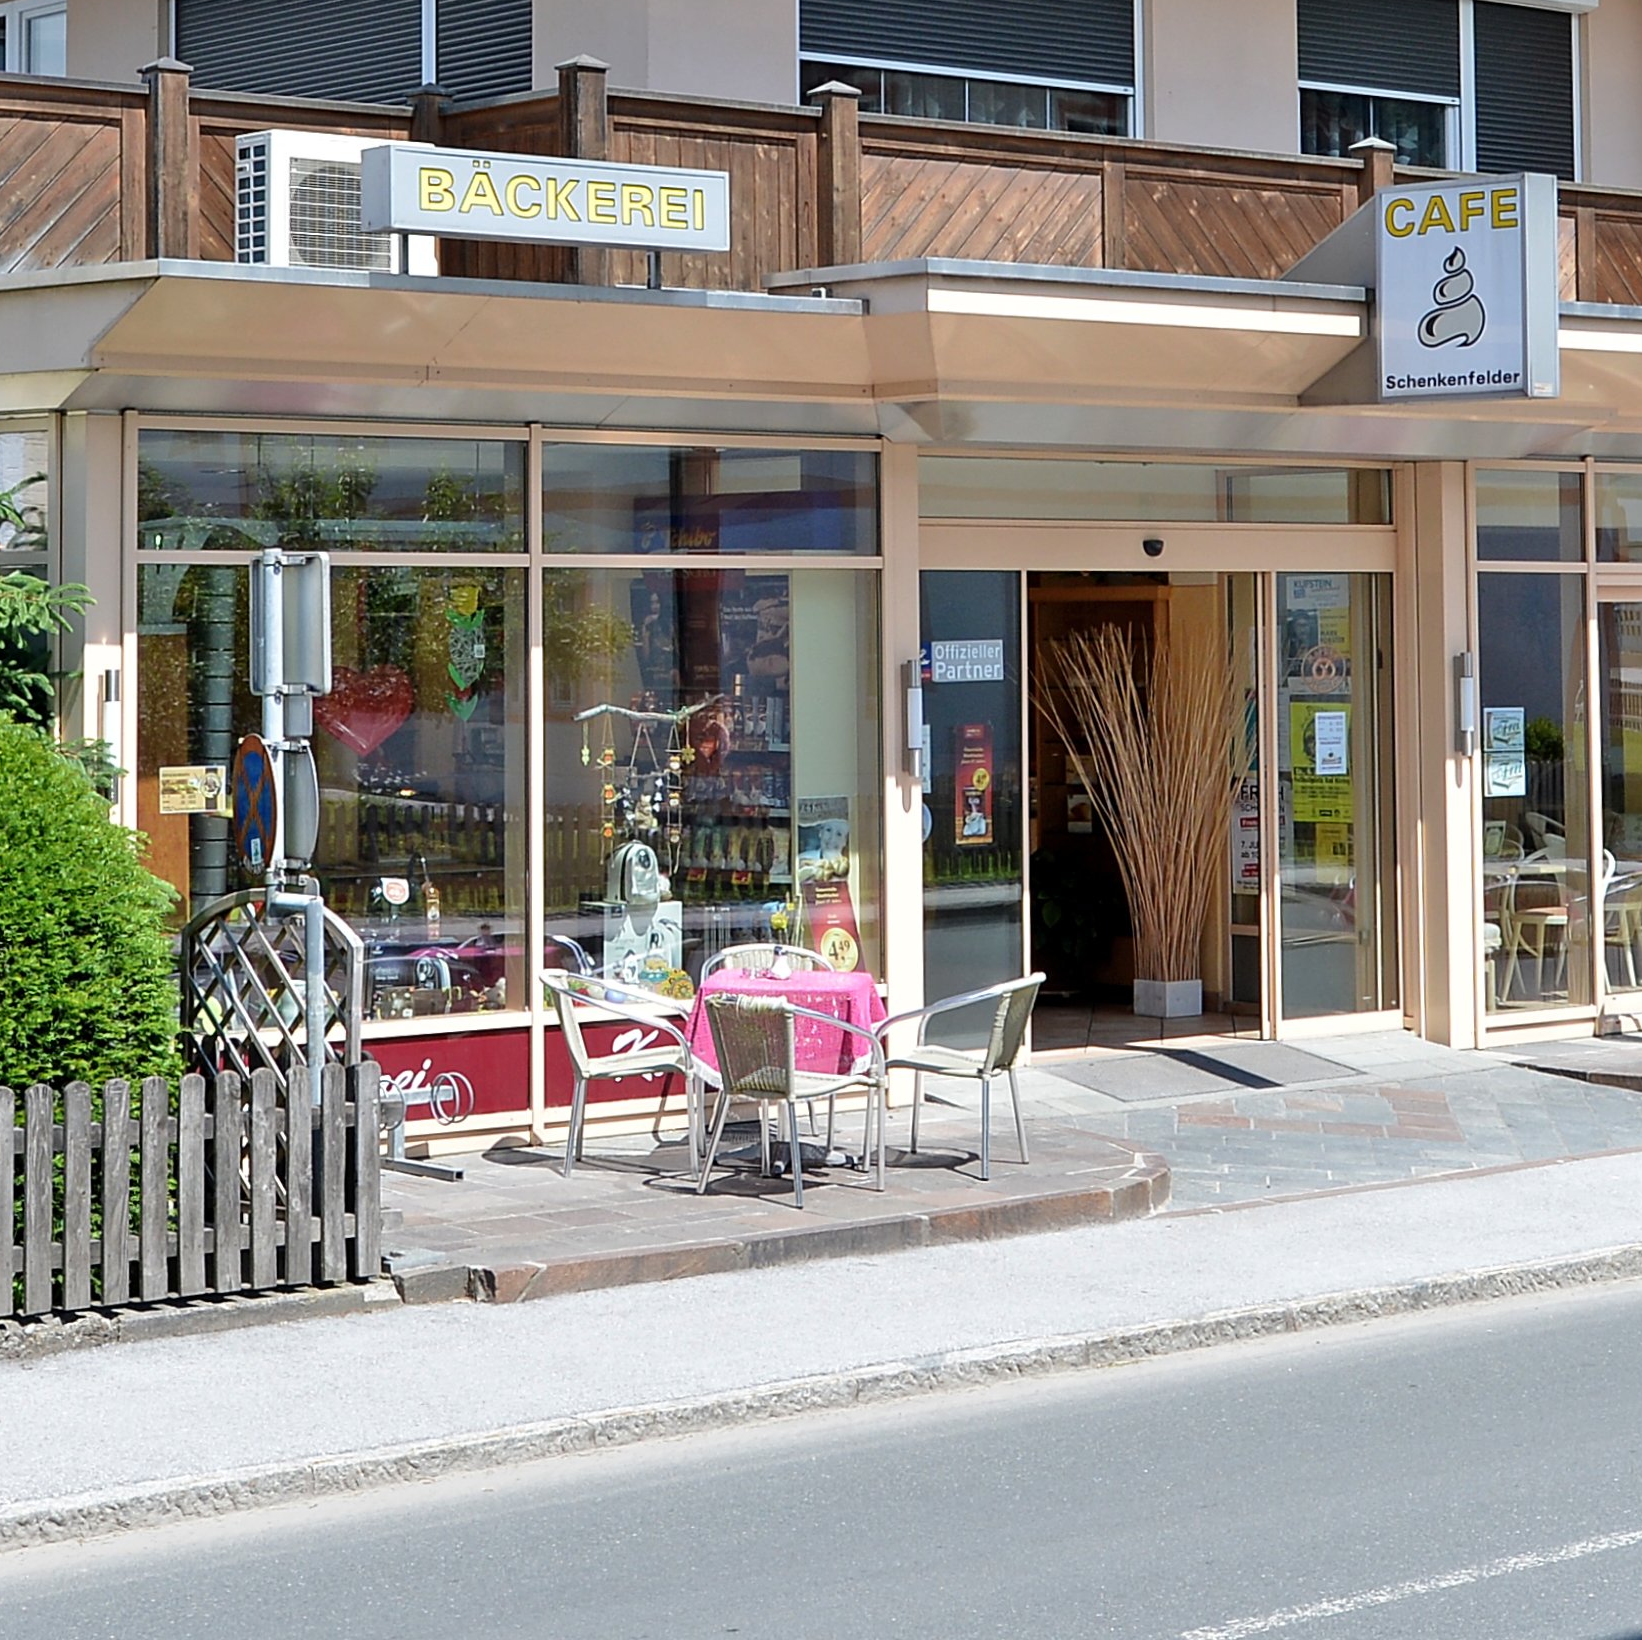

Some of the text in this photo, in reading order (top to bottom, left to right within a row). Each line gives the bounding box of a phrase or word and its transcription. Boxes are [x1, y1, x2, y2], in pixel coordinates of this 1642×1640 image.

[418, 160, 705, 231] BÄCKEREI
[1384, 188, 1519, 237] CAFE
[1385, 369, 1521, 390] Schenkenfelder
[935, 644, 1000, 660] Offizieller
[935, 661, 1001, 679] Partner
